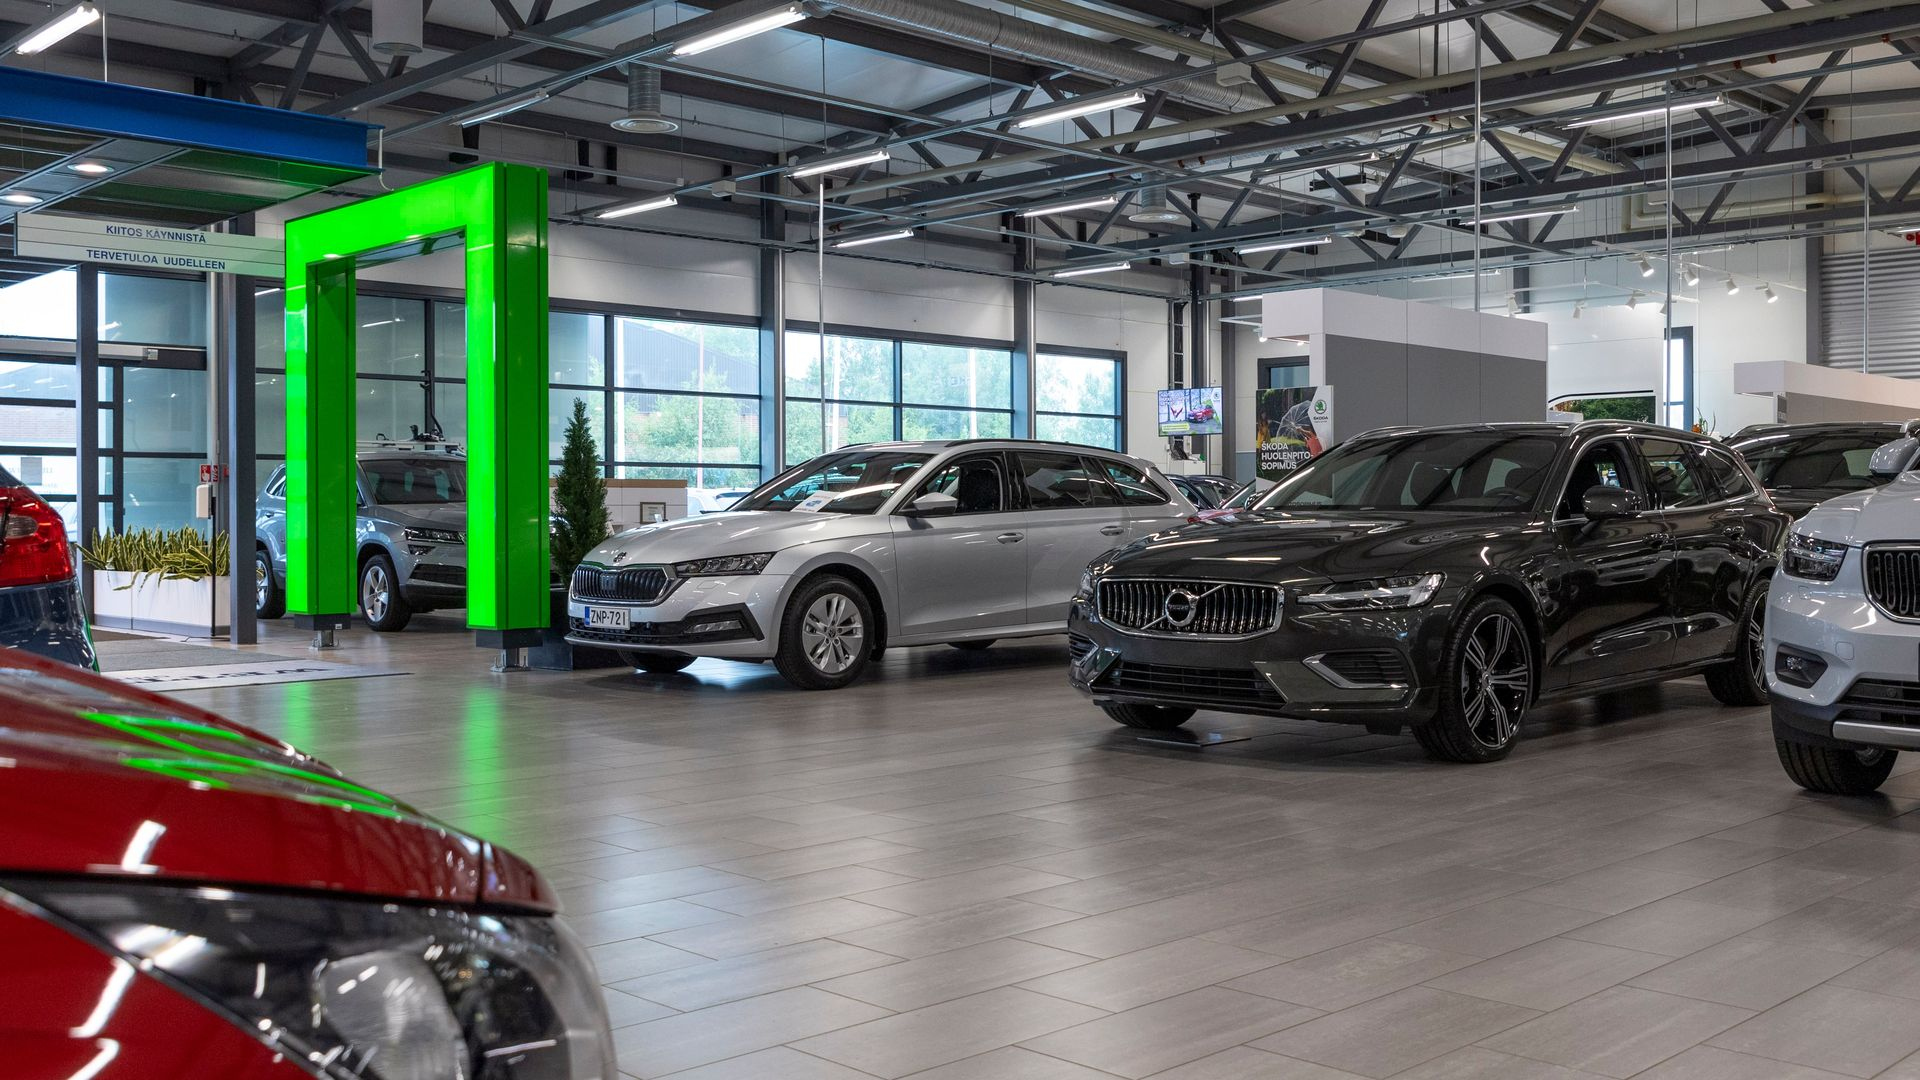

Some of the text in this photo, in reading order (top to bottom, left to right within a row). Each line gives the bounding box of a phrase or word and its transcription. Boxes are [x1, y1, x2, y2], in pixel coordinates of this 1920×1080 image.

[106, 225, 206, 243] KIITOS KÄYNNISTÄ
[86, 249, 225, 270] TERVETULOA UUDELLEEN
[1261, 441, 1289, 451] ŠKODA
[1261, 451, 1314, 460] HUOLENPITO-
[1261, 462, 1297, 470] SOPIMUS
[591, 609, 626, 625] ZNP-721
